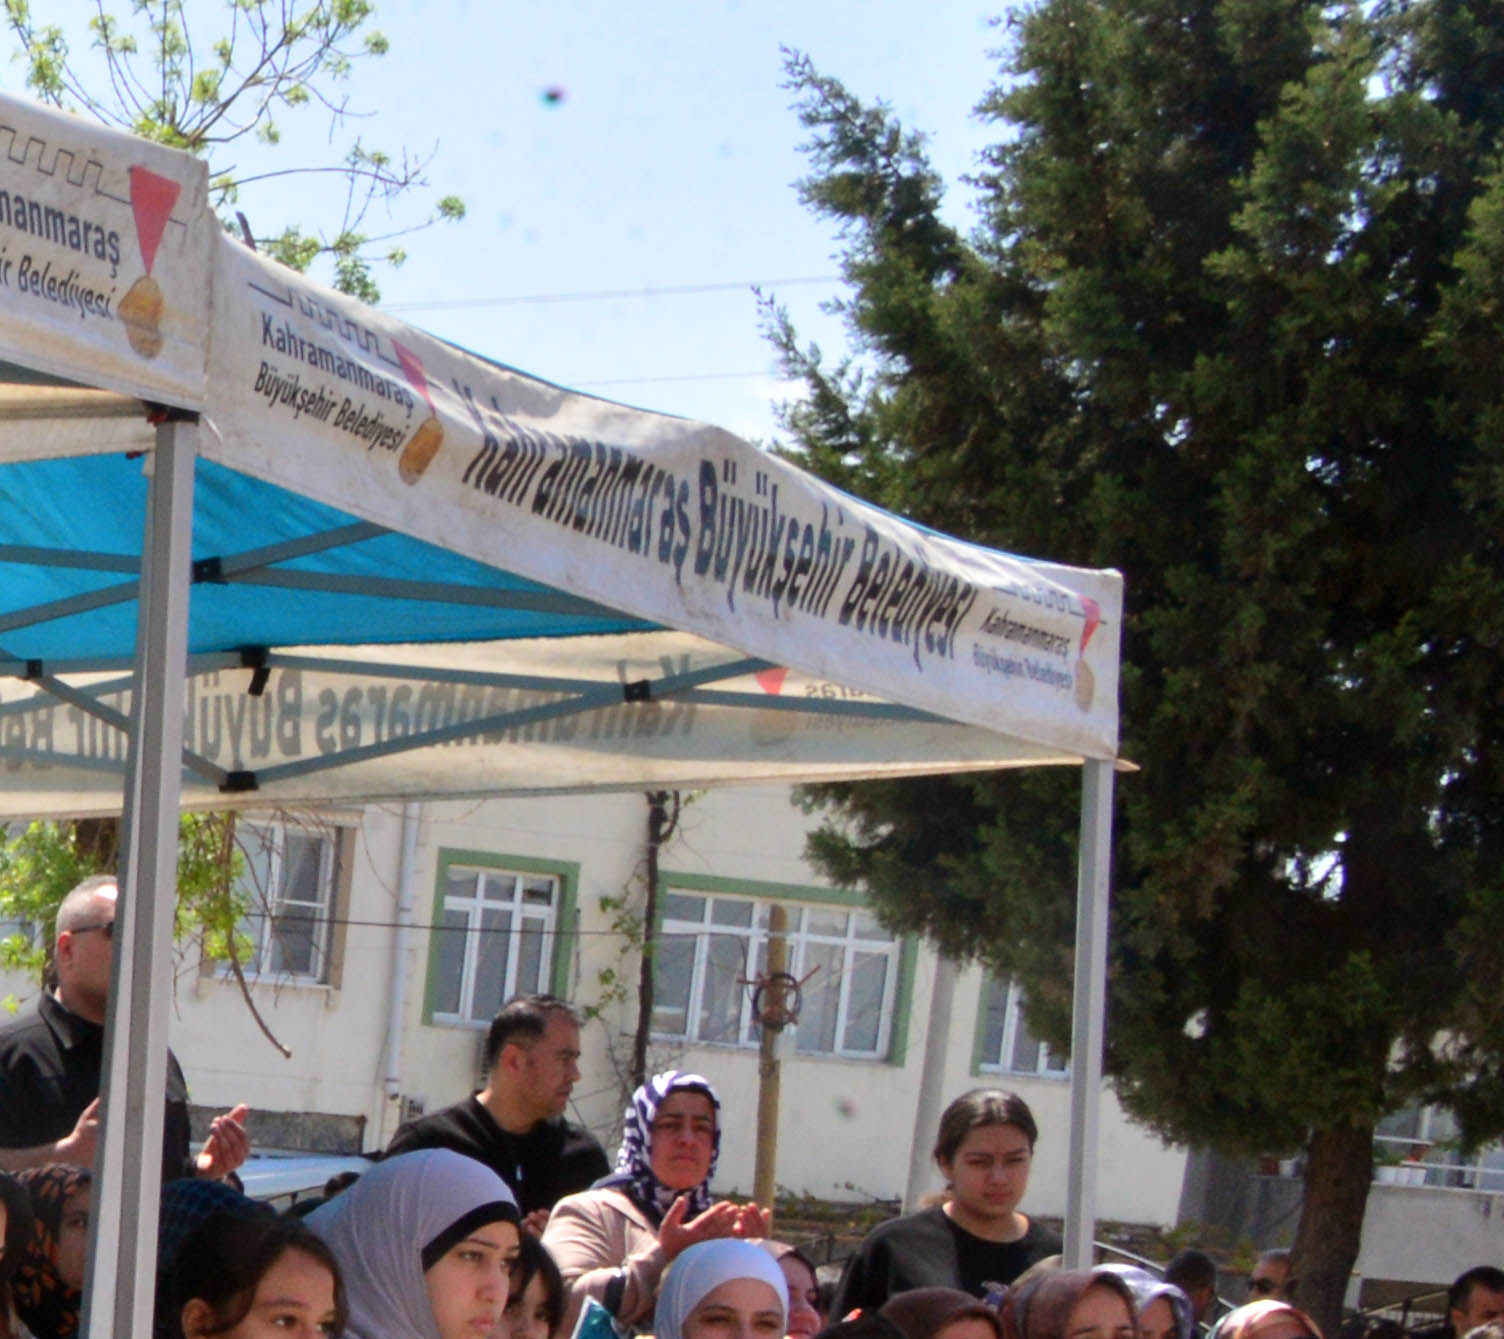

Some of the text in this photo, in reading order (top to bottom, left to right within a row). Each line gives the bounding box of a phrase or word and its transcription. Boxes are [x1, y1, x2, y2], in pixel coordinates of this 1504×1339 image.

[17, 254, 116, 320] Belediyesi
[254, 360, 410, 452] Büyükşehir Belediyesi
[262, 311, 414, 419] Kahramanmaraş
[694, 459, 855, 619] Büyükşehir
